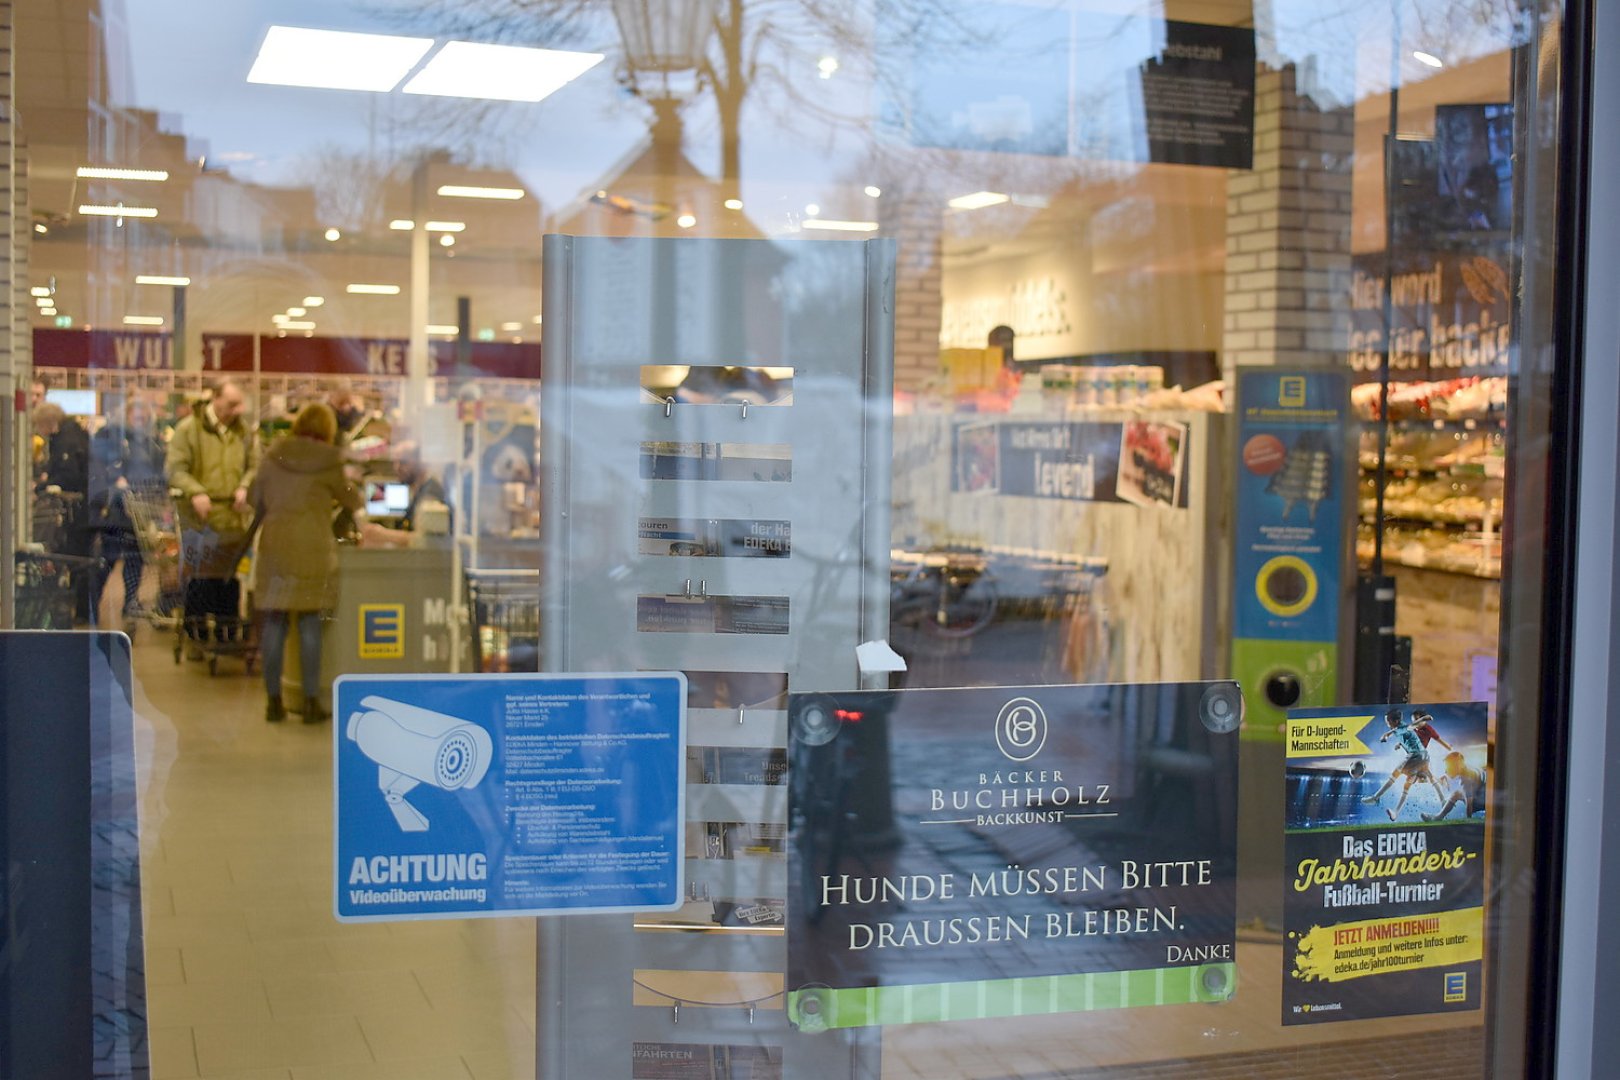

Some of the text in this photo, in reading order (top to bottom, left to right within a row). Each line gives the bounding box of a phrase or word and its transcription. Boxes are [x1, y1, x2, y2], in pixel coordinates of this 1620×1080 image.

[114, 337, 226, 369] WUT
[743, 536, 782, 551] EDEKA
[1291, 723, 1347, 740] Für D-Jugend-
[1291, 738, 1349, 752] Mannschaften
[979, 769, 1064, 785] BÄCKER
[931, 784, 1111, 811] BUCHHOLZ
[976, 810, 1064, 826] BACKKUNST
[1343, 831, 1427, 859] Das EDEKA
[349, 853, 487, 885] ACHTUNG
[1294, 846, 1476, 892] Jahrhundert-
[350, 886, 487, 905] Videoüberwachung
[820, 860, 1211, 906] HUNDE MÜSSEN BITTE
[1323, 881, 1444, 908] Fußball-Turnier
[848, 906, 1185, 951] DRAUSSEN BLEIBEN.
[1333, 917, 1440, 946] JETZT ANMELDEN!!!!
[1167, 944, 1230, 963] DANKE
[1334, 935, 1468, 961] Anmeldung und weitere Infos unter:
[1334, 953, 1425, 974] edeka.de/jahr100turnier
